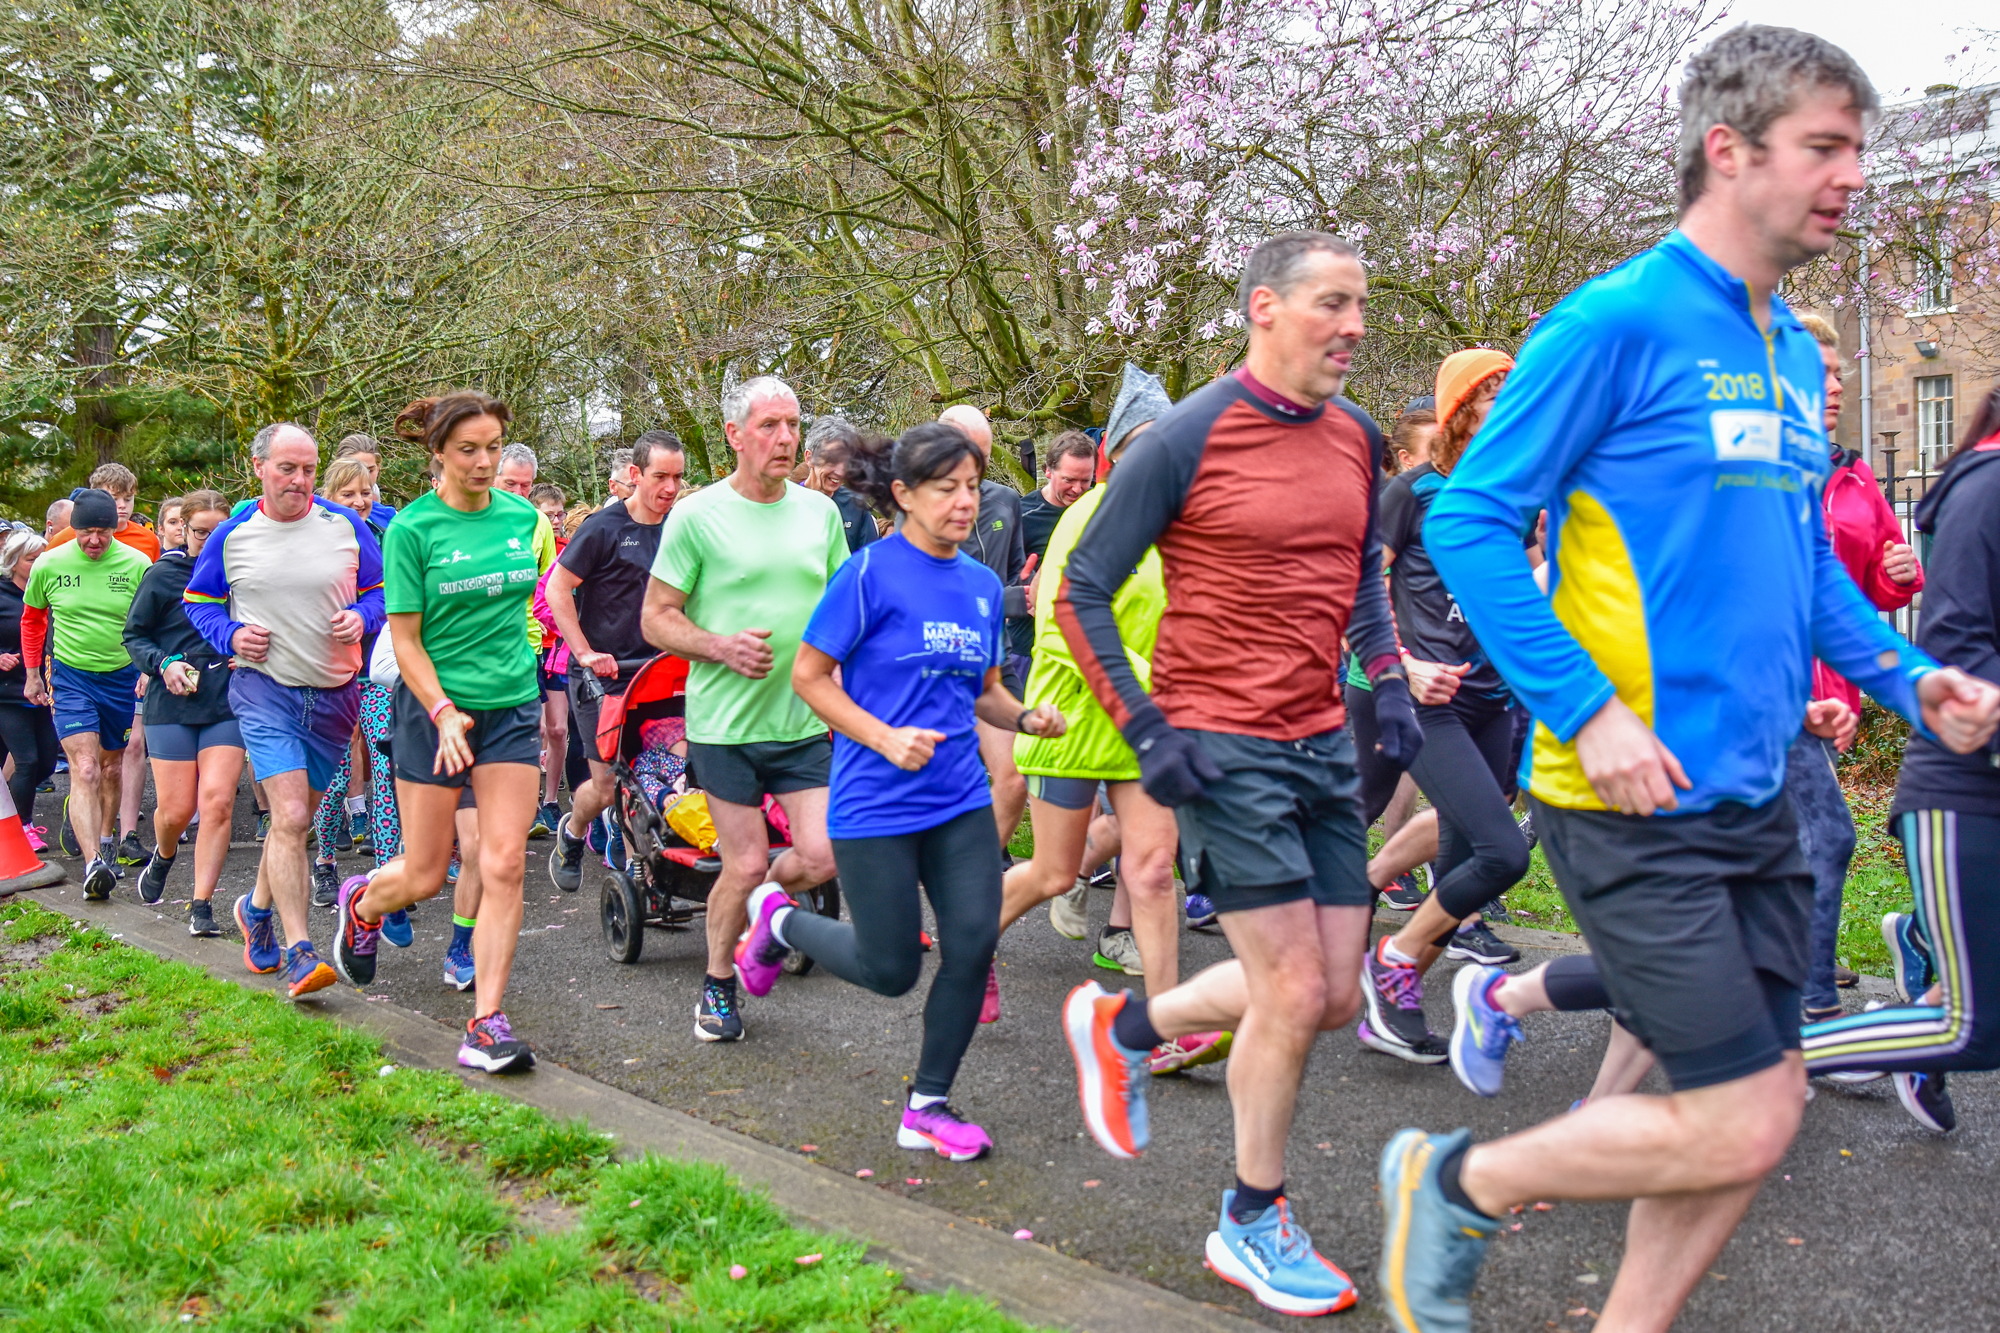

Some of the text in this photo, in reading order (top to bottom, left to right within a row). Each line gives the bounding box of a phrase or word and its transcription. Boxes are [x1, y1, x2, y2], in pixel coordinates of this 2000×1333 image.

[1703, 372, 1766, 400] 2018
[57, 575, 81, 587] 13.1
[109, 575, 130, 583] Tralee
[440, 572, 504, 594] KINGDOM
